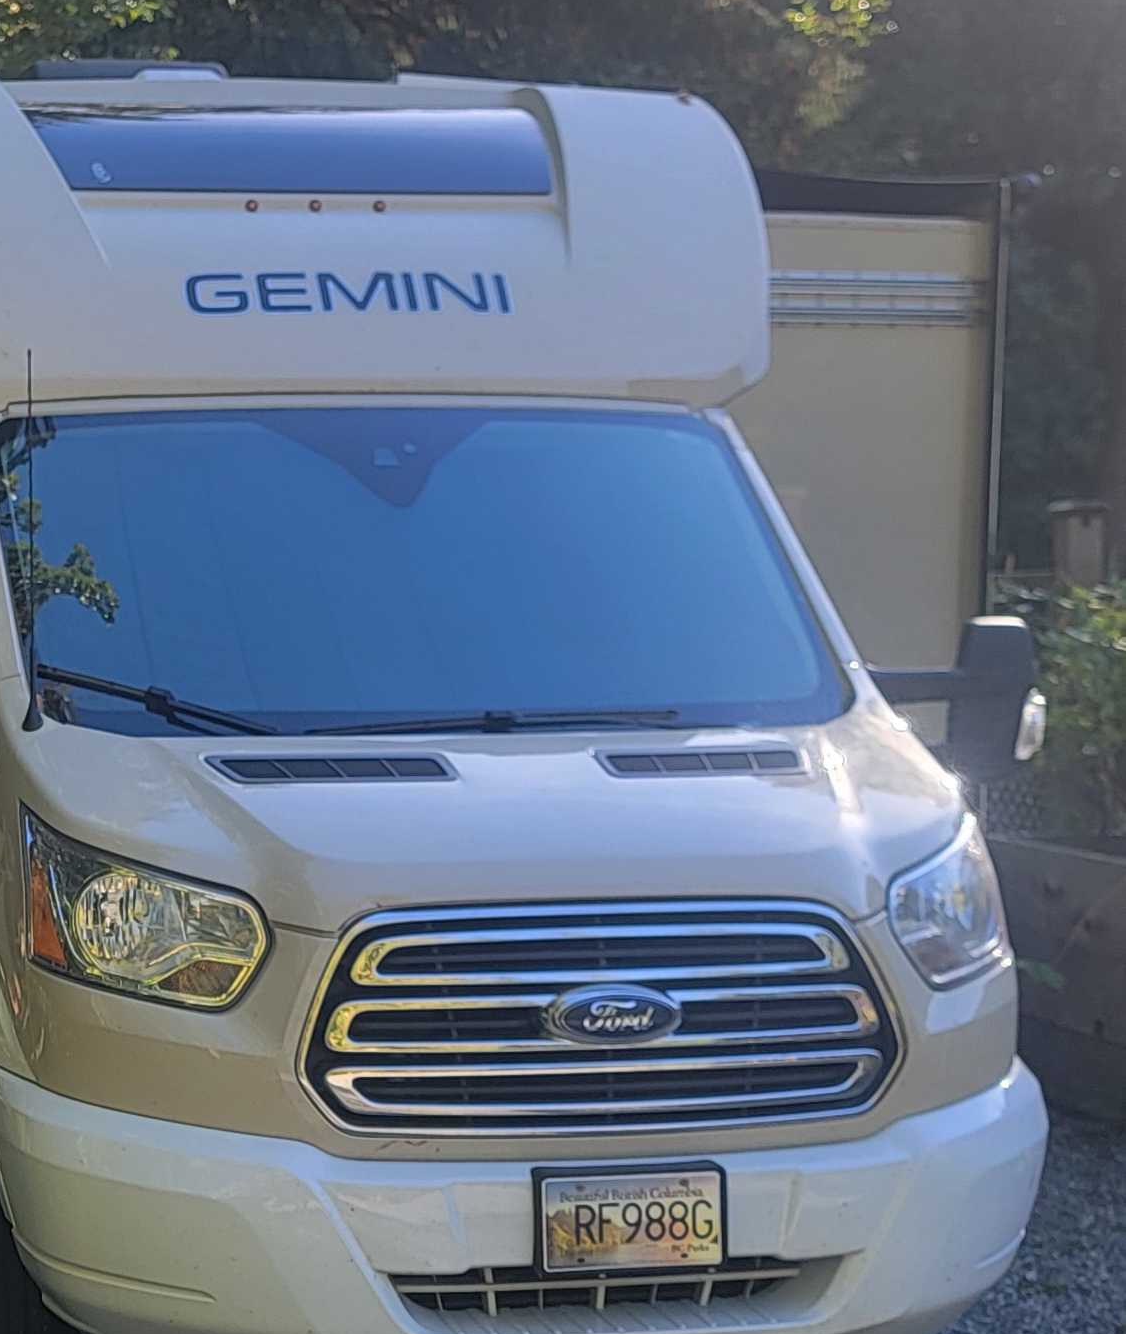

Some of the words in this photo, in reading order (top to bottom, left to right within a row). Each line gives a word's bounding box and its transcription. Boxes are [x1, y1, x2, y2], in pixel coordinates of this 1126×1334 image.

[185, 271, 511, 314] GEMINI
[582, 999, 655, 1033] Ford
[574, 1199, 714, 1246] RF988G
